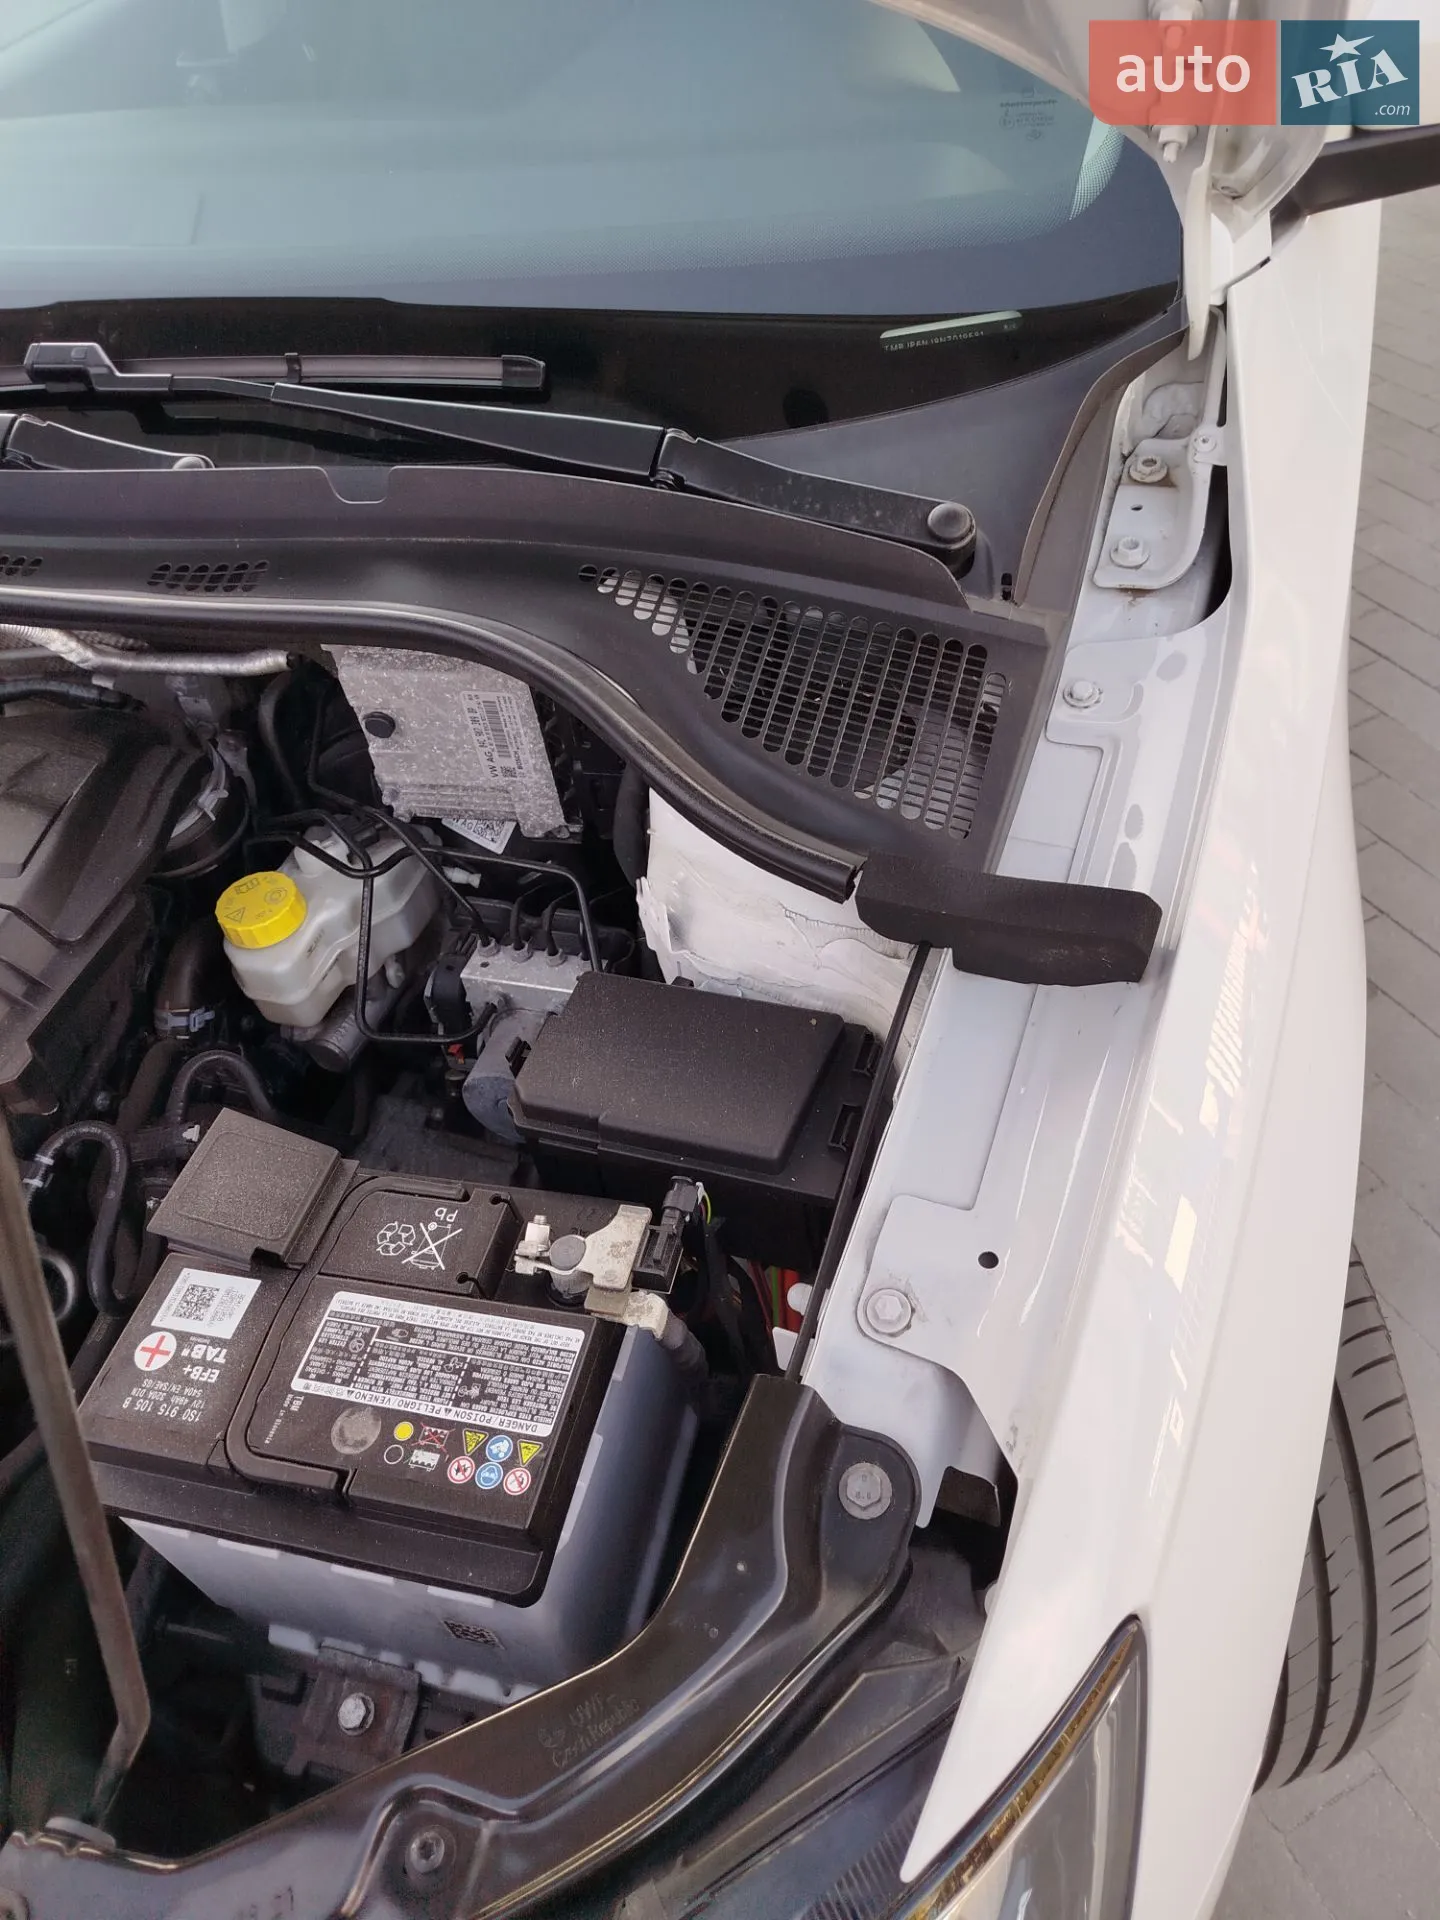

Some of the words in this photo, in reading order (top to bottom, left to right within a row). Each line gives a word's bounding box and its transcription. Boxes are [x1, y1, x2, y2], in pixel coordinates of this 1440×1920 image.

[487, 765, 499, 778] VW
[434, 1207, 459, 1223] Pb
[190, 1344, 228, 1364] TAB
[182, 1365, 220, 1383] EFB+
[131, 1387, 147, 1397] DIN
[183, 1386, 203, 1398] 540A
[122, 1397, 132, 1409] B
[134, 1399, 154, 1412] 105
[191, 1400, 206, 1409] 12V
[353, 1389, 442, 1416] PELIGRO/VENENO
[158, 1404, 179, 1417] 915
[182, 1408, 202, 1422] 1S0
[452, 1408, 538, 1433] DANGER/POISON
